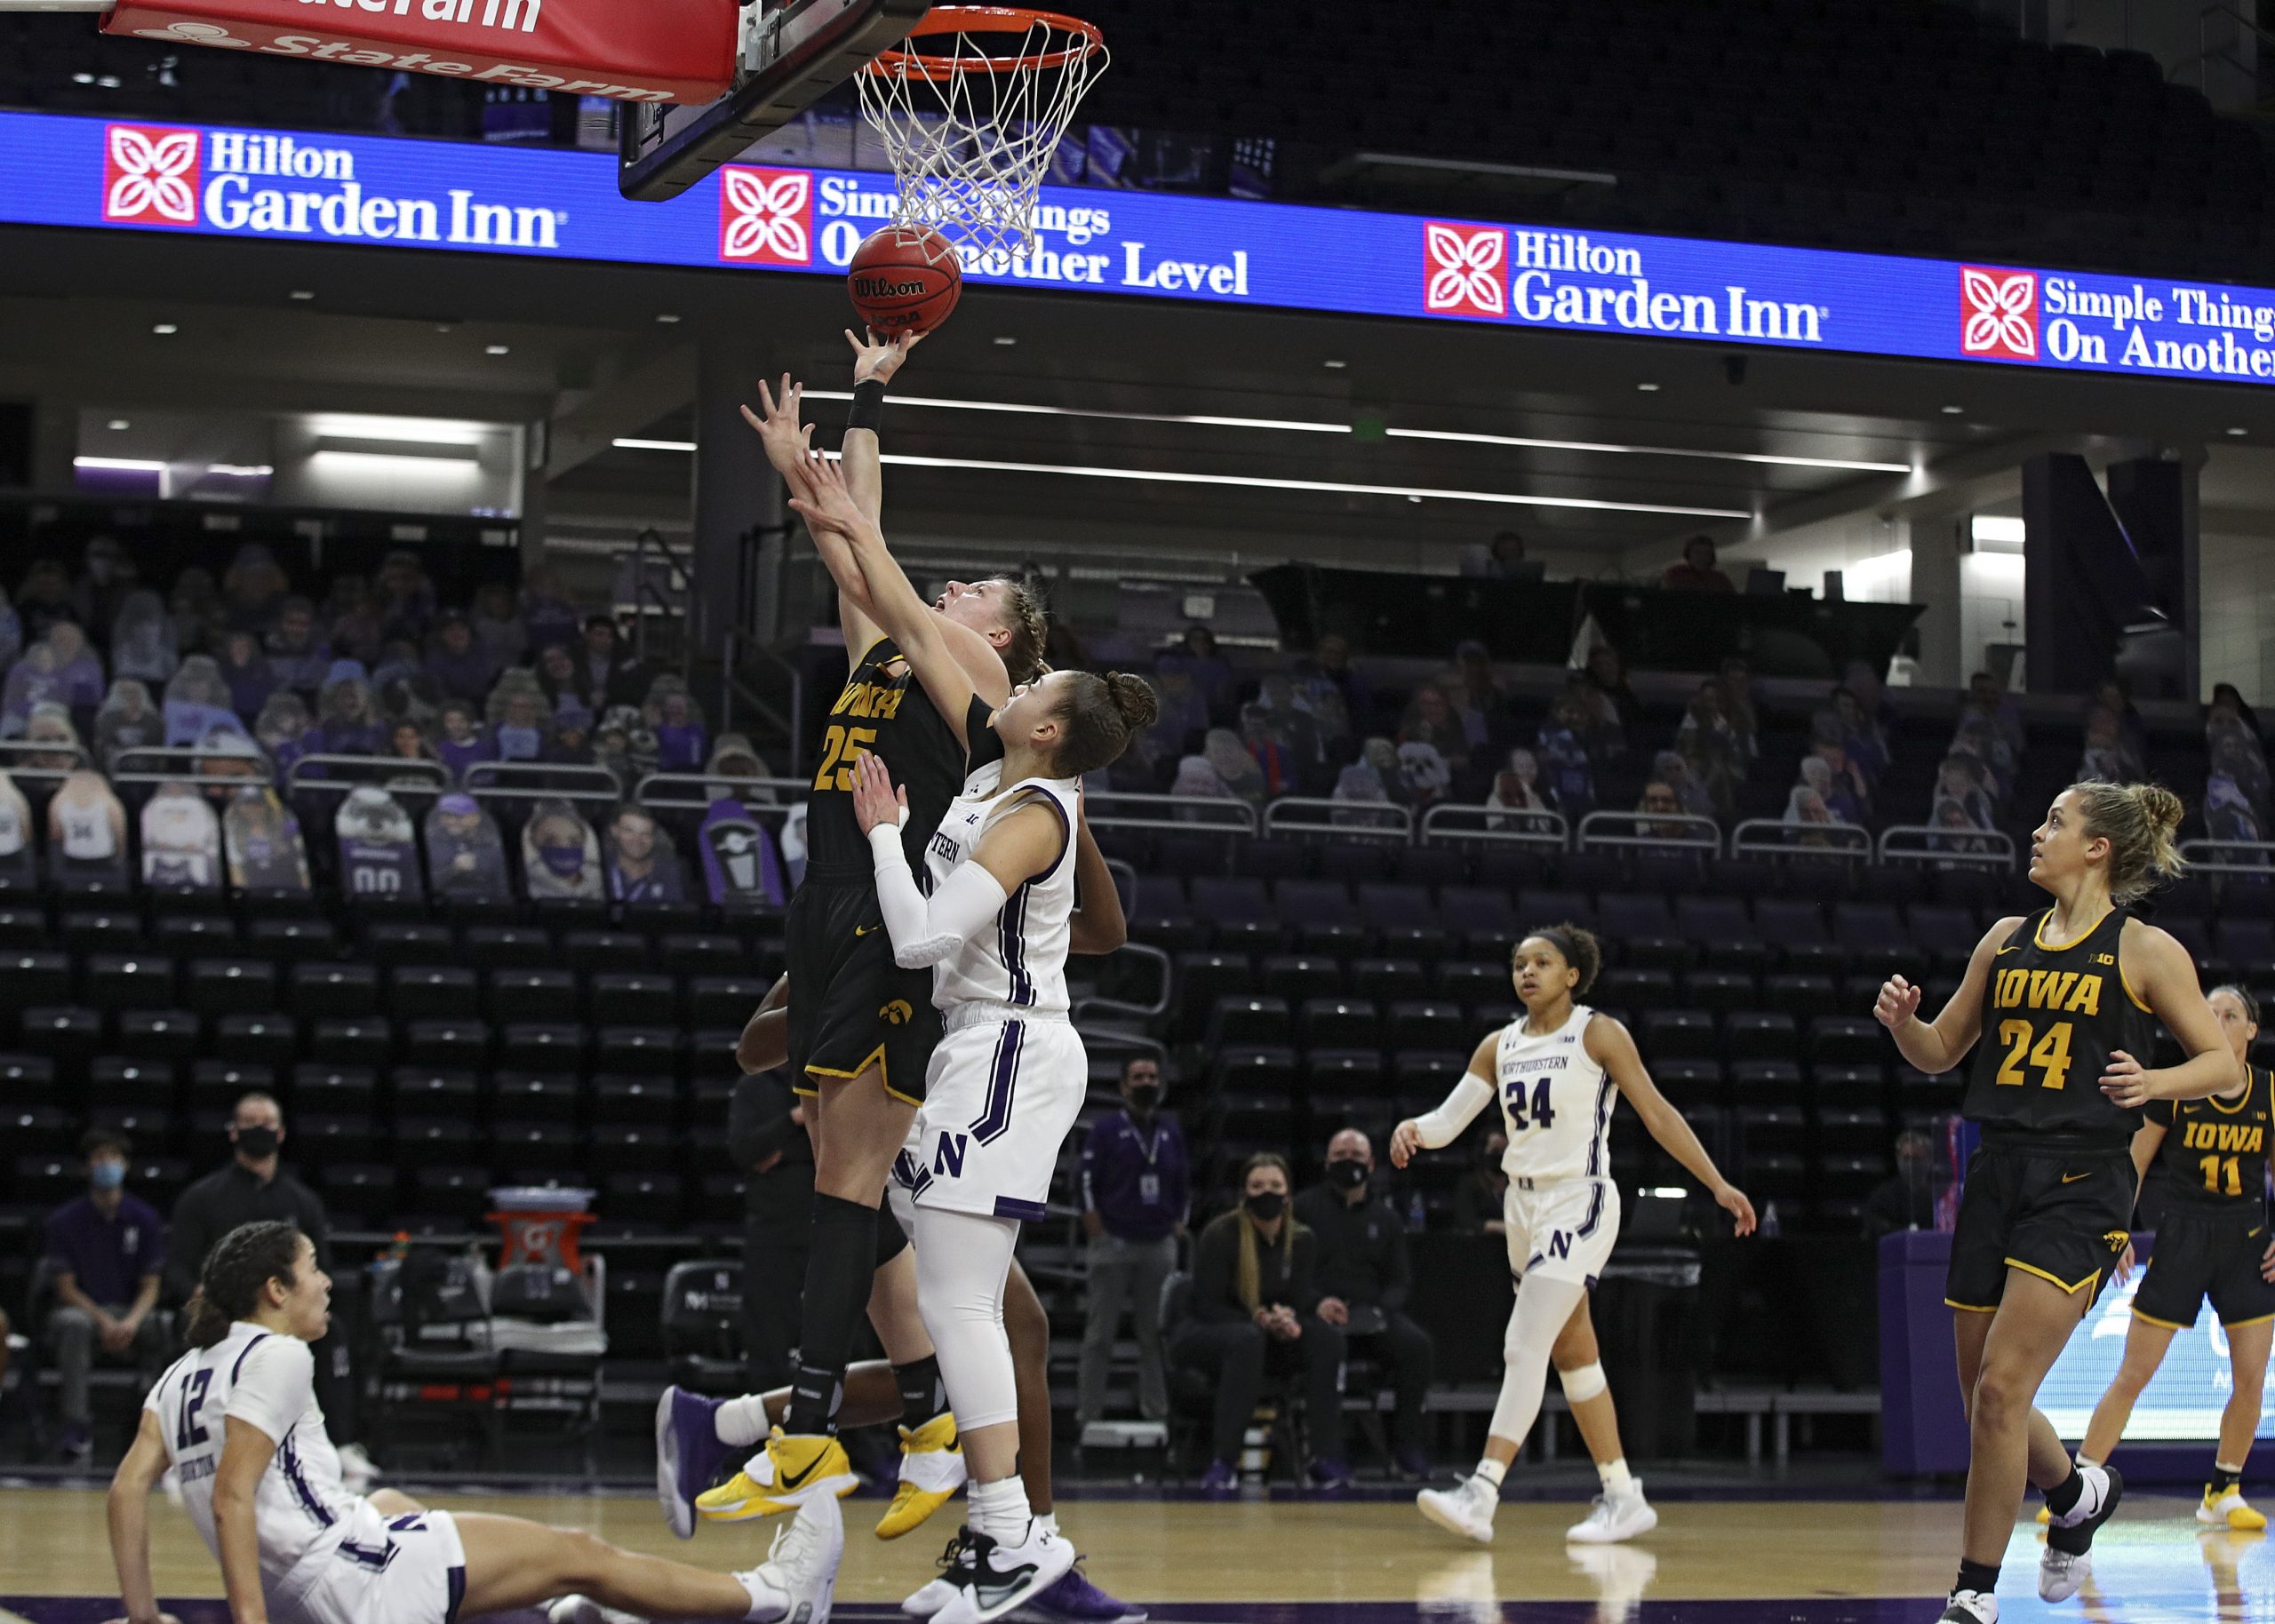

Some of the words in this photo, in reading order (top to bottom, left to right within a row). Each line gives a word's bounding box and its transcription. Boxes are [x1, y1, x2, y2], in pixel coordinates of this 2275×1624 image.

[209, 132, 355, 180] Hilton
[204, 174, 442, 242] Garden
[820, 220, 865, 267] O
[954, 235, 1110, 283] nother
[1121, 241, 1249, 296] Level
[1515, 230, 1643, 277] Hilton
[855, 277, 925, 299] Wilson
[1513, 269, 1720, 332] Garden
[2045, 277, 2163, 330] Simple
[2172, 287, 2275, 343] Thing
[2047, 318, 2109, 364] On
[2119, 323, 2275, 378] Anothe
[814, 725, 878, 792] 25
[1993, 968, 2103, 1017] IOWA
[1502, 1055, 1569, 1076] NORTHWESTERN
[1996, 1019, 2073, 1091] 24
[1506, 1078, 1556, 1131] 24
[934, 1130, 969, 1179] N
[2183, 1121, 2264, 1152] IOWA
[2199, 1155, 2242, 1197] 11
[1548, 1230, 1573, 1261] N
[177, 1368, 214, 1451] 12
